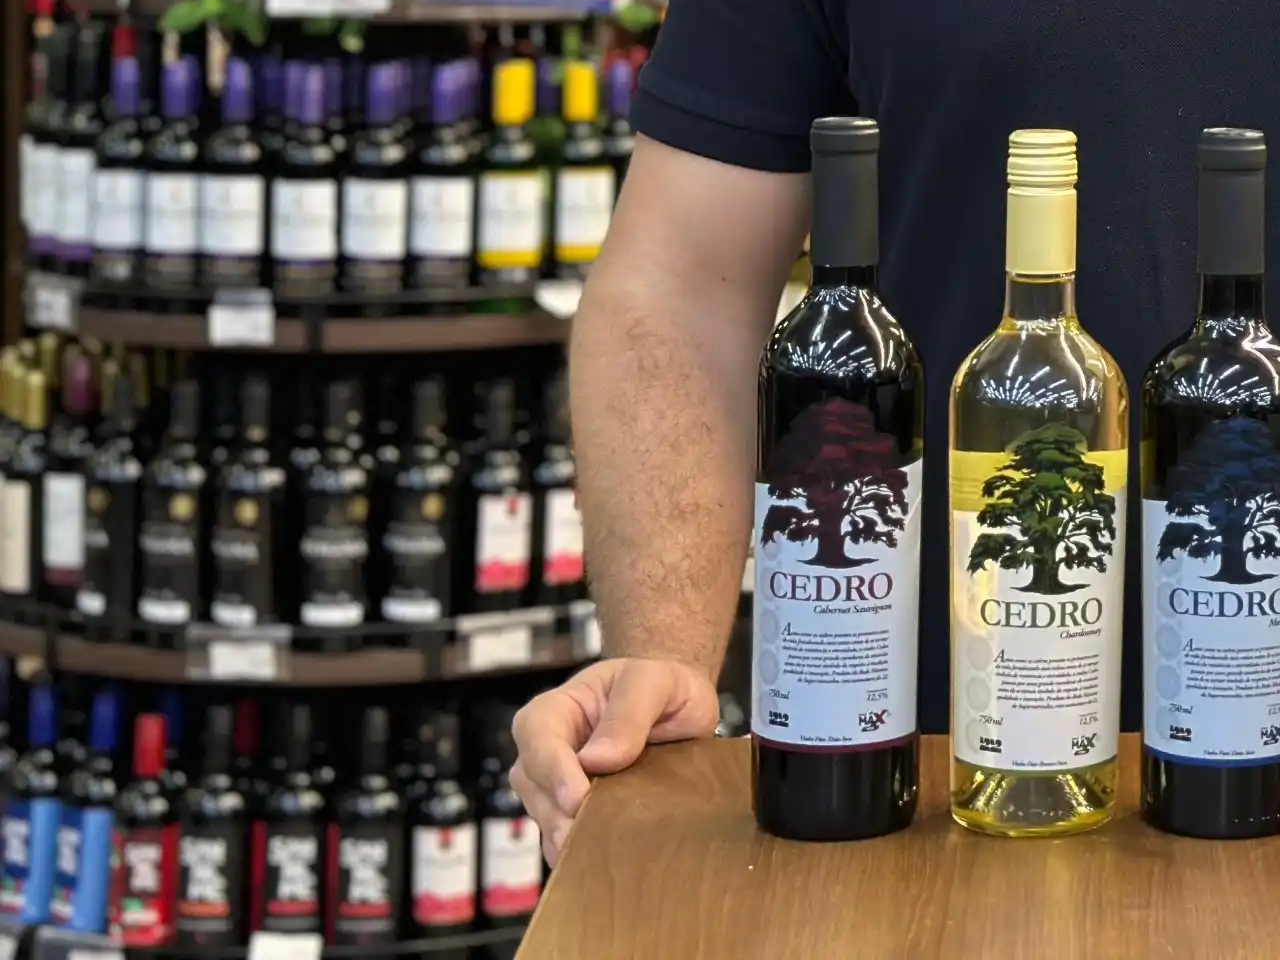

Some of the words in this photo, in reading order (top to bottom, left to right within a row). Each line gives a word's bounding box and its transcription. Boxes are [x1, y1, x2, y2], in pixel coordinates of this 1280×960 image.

[769, 571, 894, 602] CEDRO
[813, 604, 851, 614] Cabernet
[852, 603, 892, 615] Sauvignon
[980, 597, 1103, 628] CEDRO
[1060, 628, 1102, 639] Chardonnay
